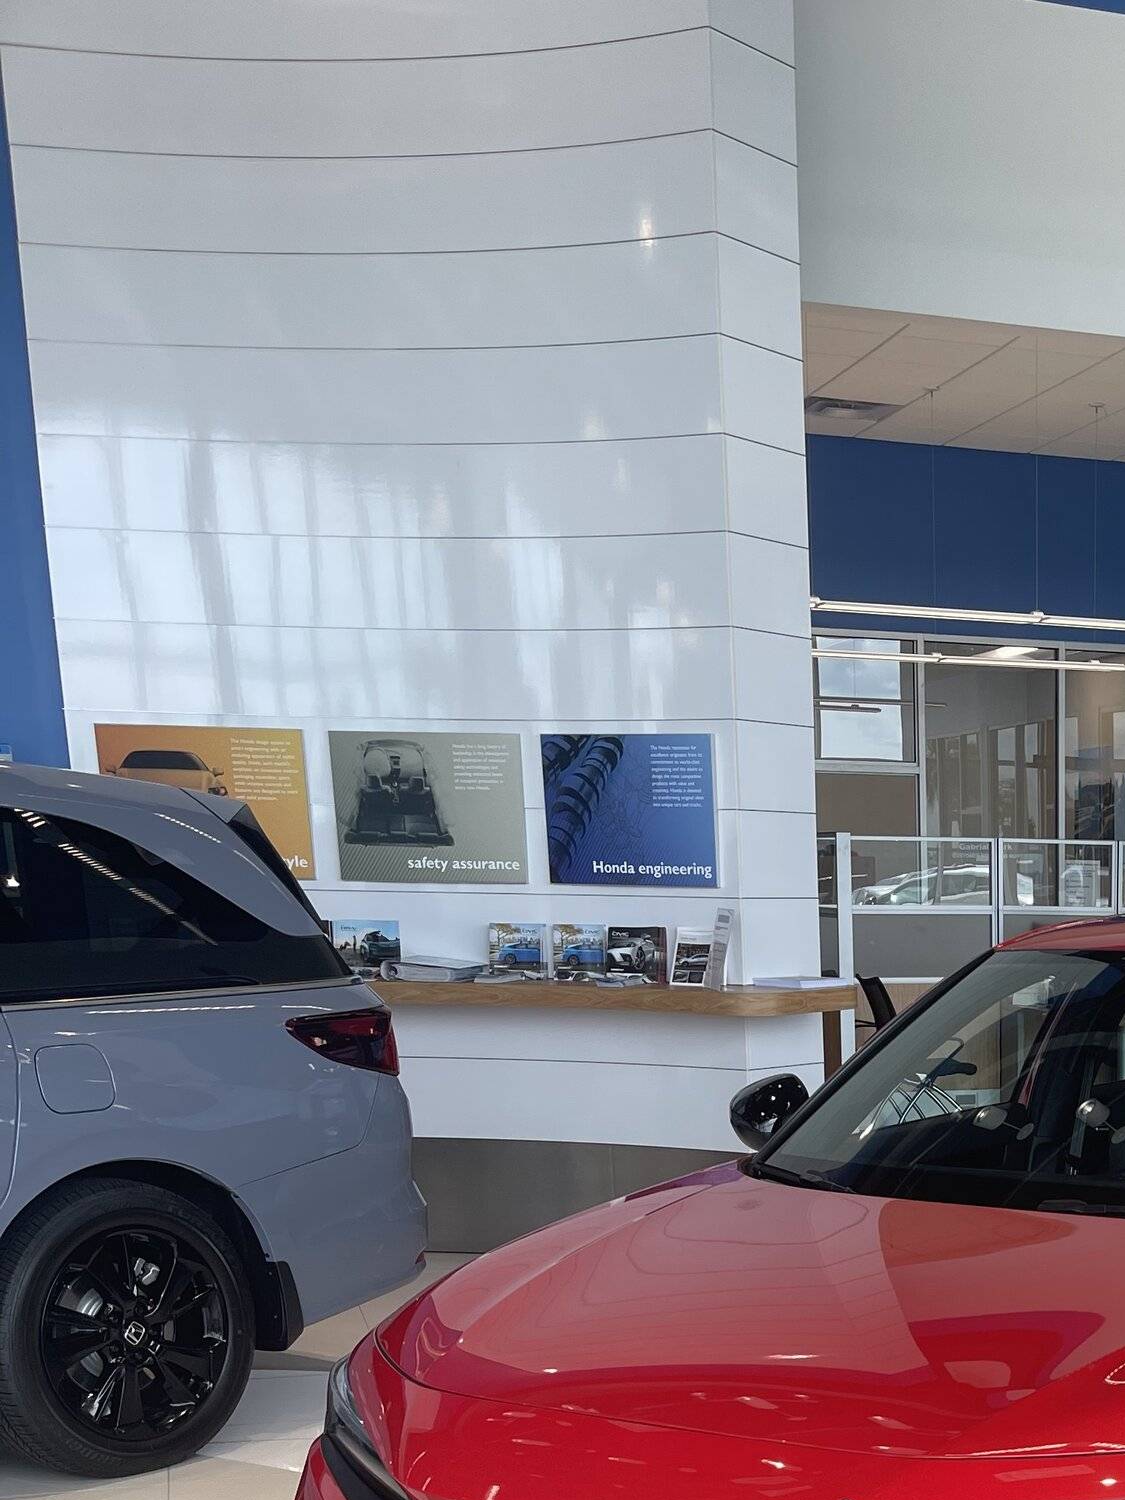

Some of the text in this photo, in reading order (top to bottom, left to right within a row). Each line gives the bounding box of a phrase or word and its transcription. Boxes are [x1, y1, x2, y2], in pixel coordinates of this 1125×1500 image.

[408, 856, 520, 872] safety assurance
[592, 861, 713, 879] Honda engineering
